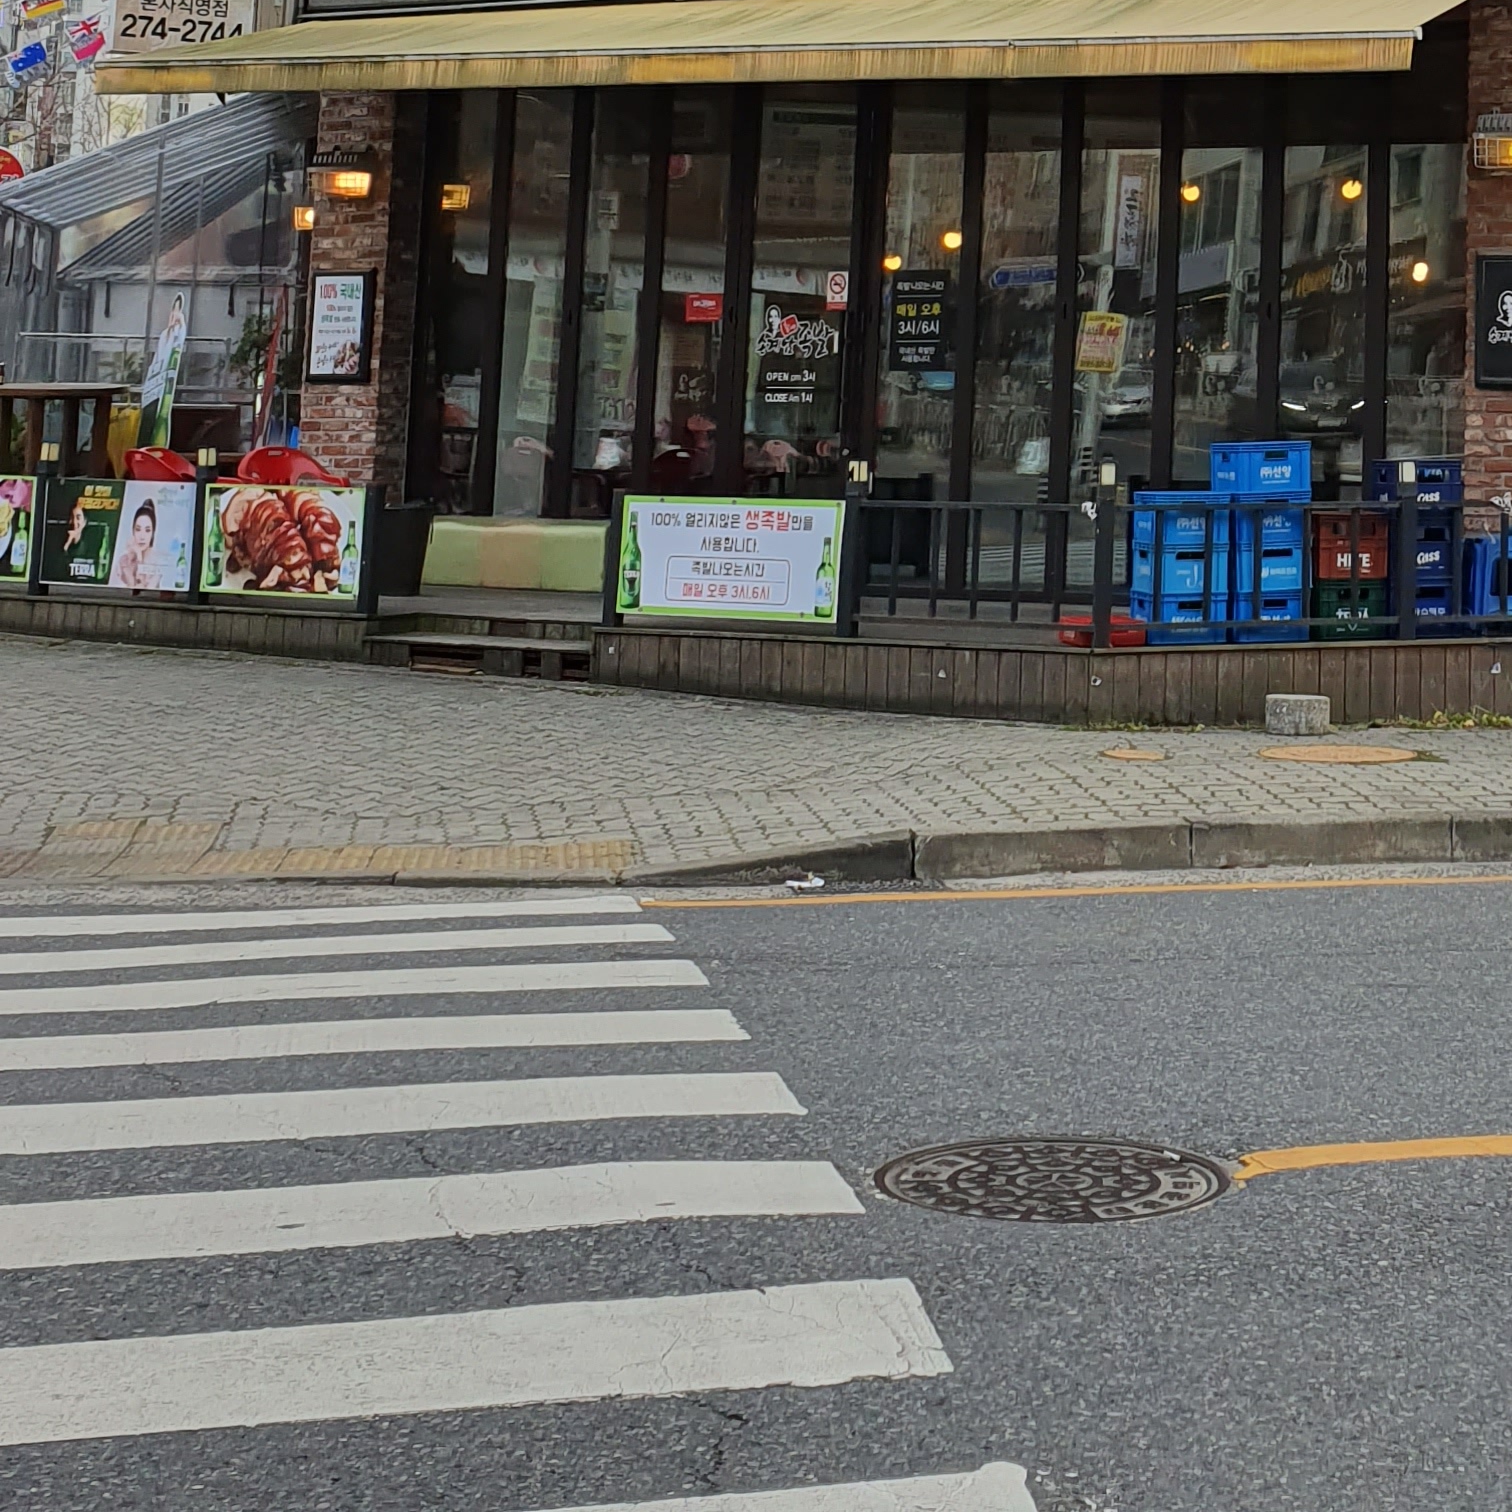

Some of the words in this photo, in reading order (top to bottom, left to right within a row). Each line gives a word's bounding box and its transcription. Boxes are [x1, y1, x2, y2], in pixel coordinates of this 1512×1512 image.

[898, 319, 940, 335] 3시/6시
[766, 372, 789, 382] OPEN
[802, 369, 816, 382] 3시
[764, 393, 789, 403] CLOSE
[651, 512, 681, 528] 100%
[1337, 553, 1371, 568] HIE
[707, 584, 728, 599] 오후
